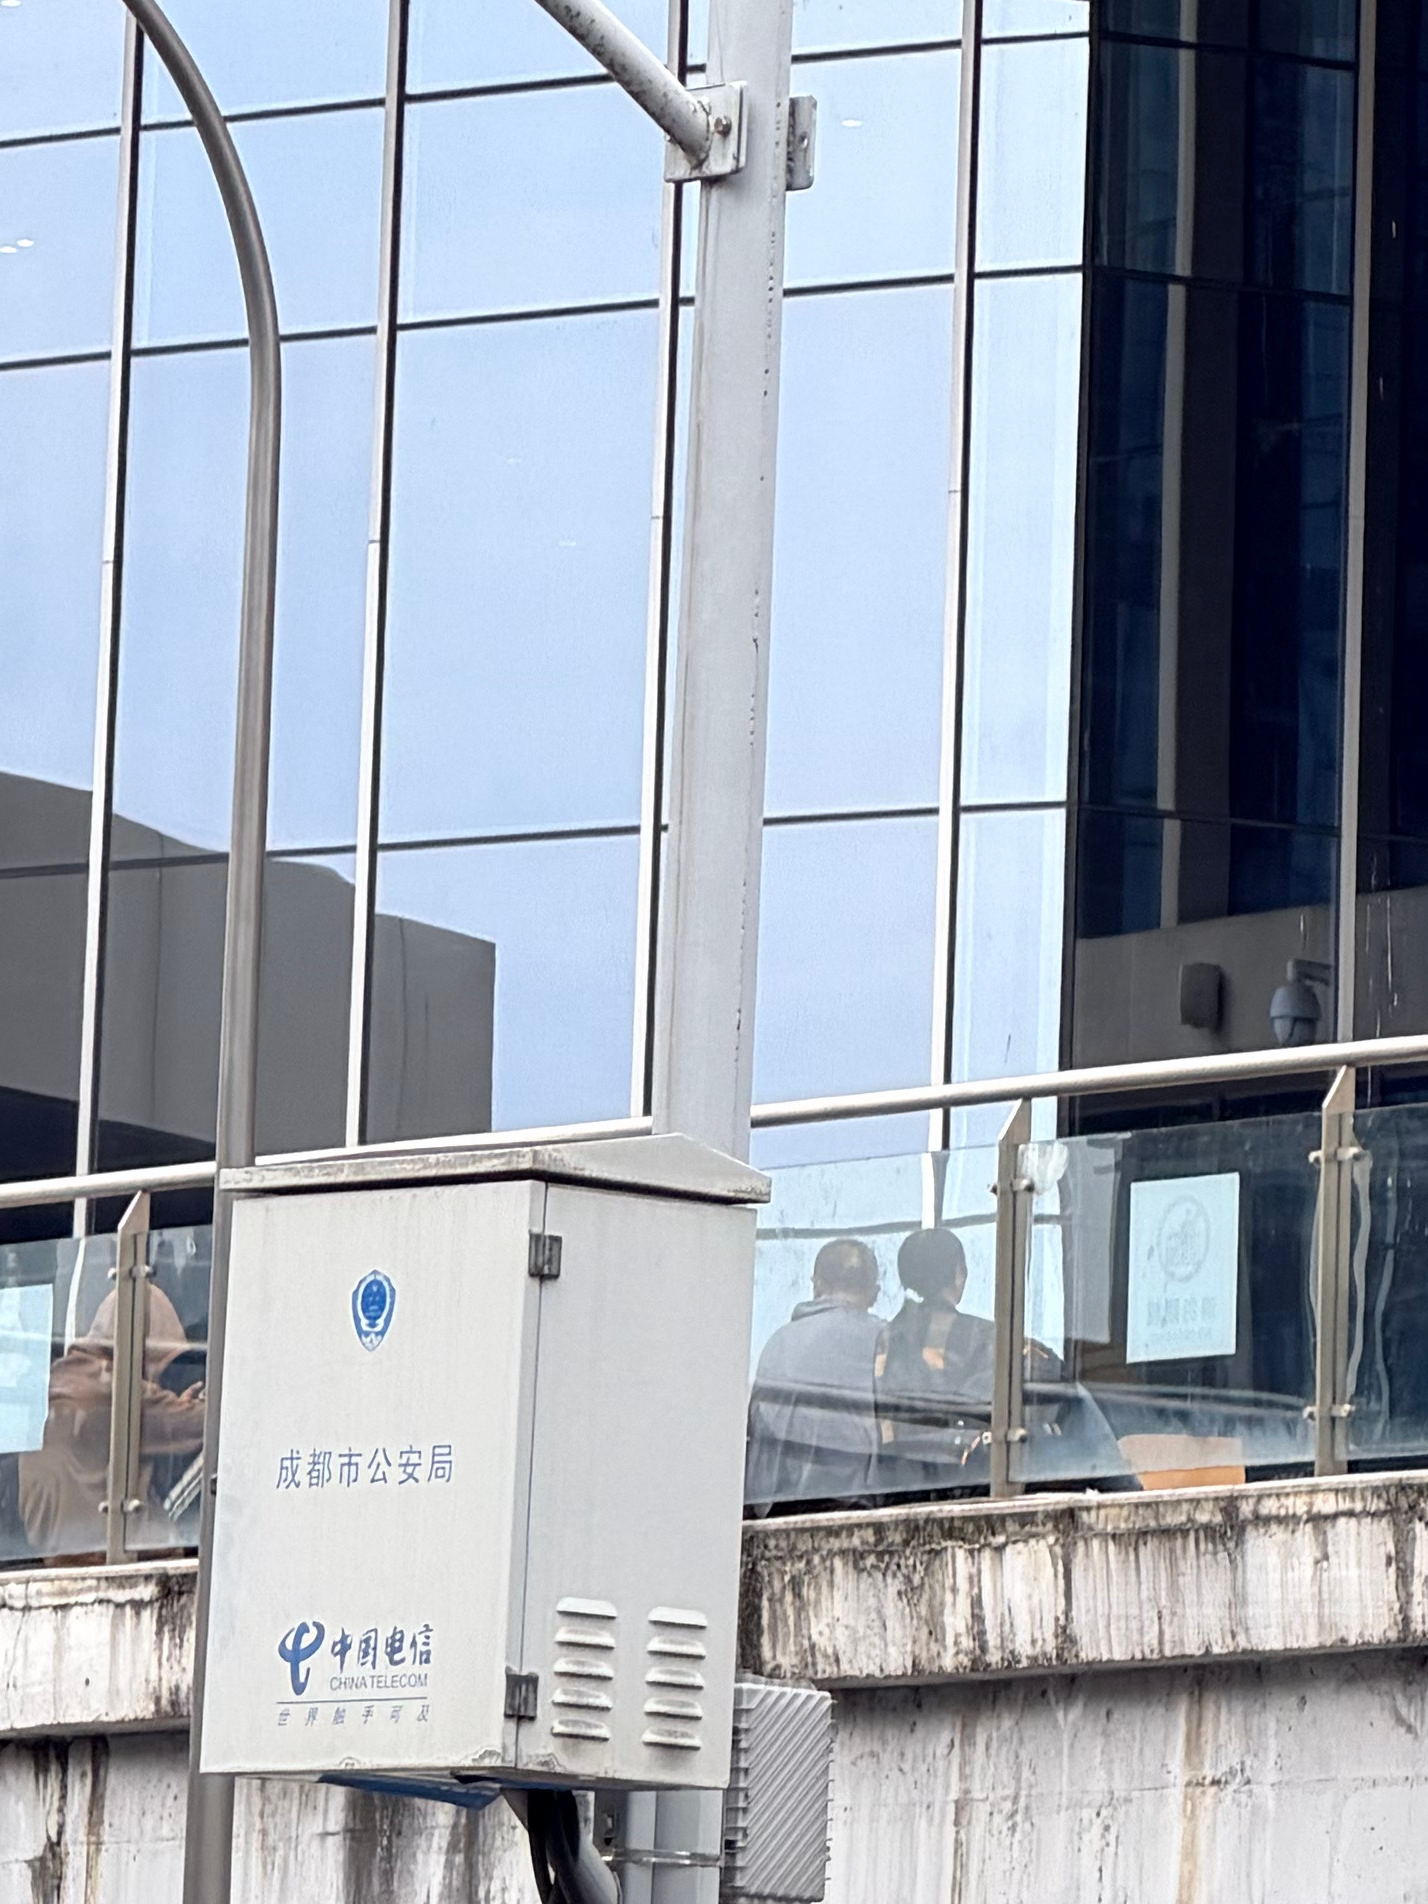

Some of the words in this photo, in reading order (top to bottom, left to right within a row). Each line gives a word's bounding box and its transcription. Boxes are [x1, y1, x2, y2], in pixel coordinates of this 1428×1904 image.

[276, 1444, 453, 1489] 成都市公安局
[330, 1623, 434, 1674] 中国电信
[329, 1676, 368, 1691] CHINA
[370, 1672, 428, 1689] TELECOM
